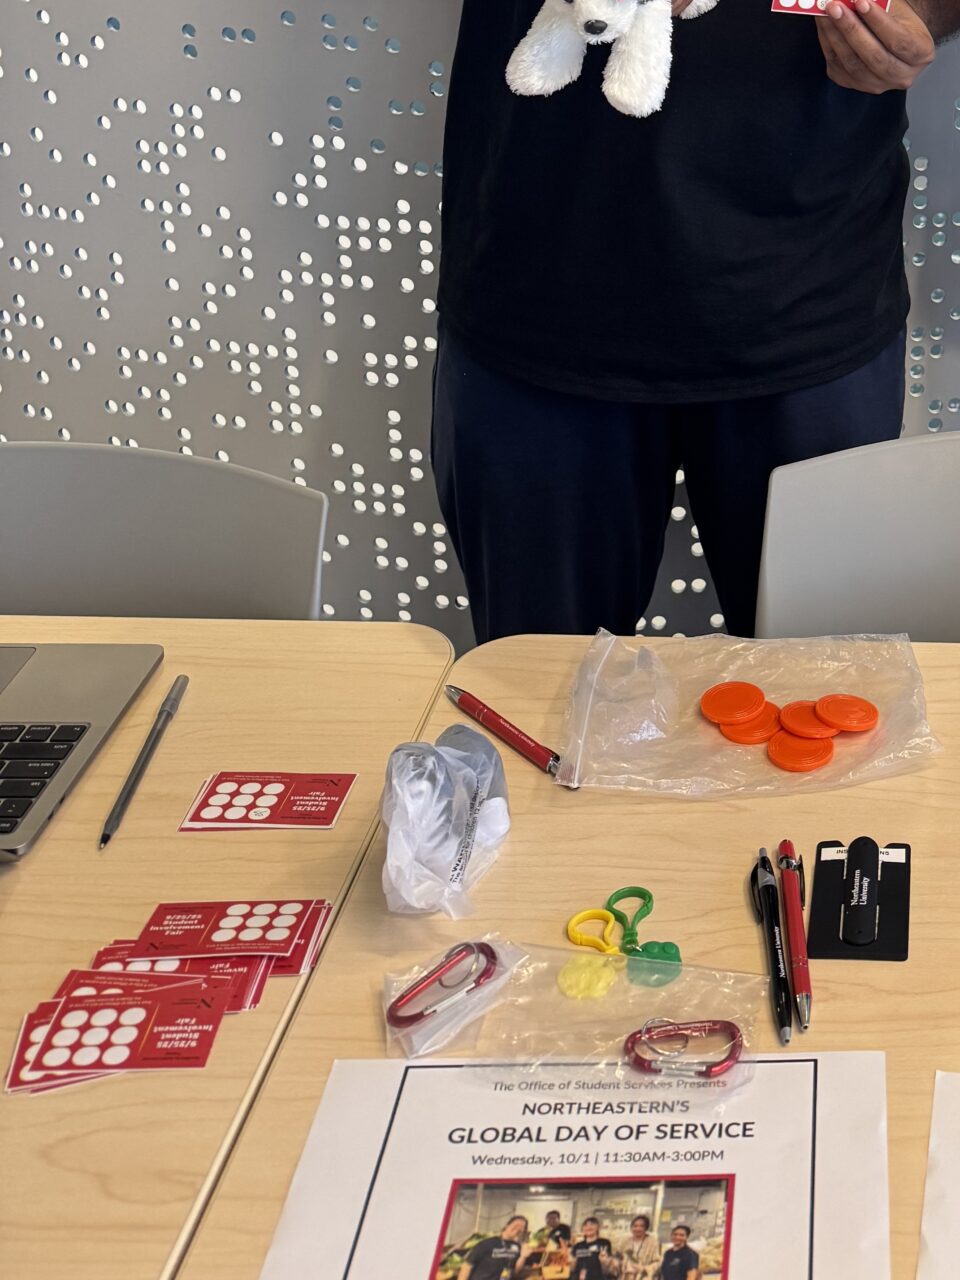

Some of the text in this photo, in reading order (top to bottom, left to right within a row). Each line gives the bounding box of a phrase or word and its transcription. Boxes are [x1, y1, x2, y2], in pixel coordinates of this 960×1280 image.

[850, 869, 861, 906] Northeastern
[859, 876, 870, 905] University
[153, 1024, 213, 1033] Involvement
[161, 1032, 200, 1041] Student
[493, 1079, 728, 1091] The Office of Student Services Presents
[522, 1100, 690, 1115] NORTHEASTERN'S
[448, 1121, 755, 1144] GLOBAL DAY OF SERVICE
[471, 1153, 554, 1167] Wednesday,
[558, 1152, 590, 1165] 10/1
[604, 1150, 724, 1164] 11:30AM-3:00PM
